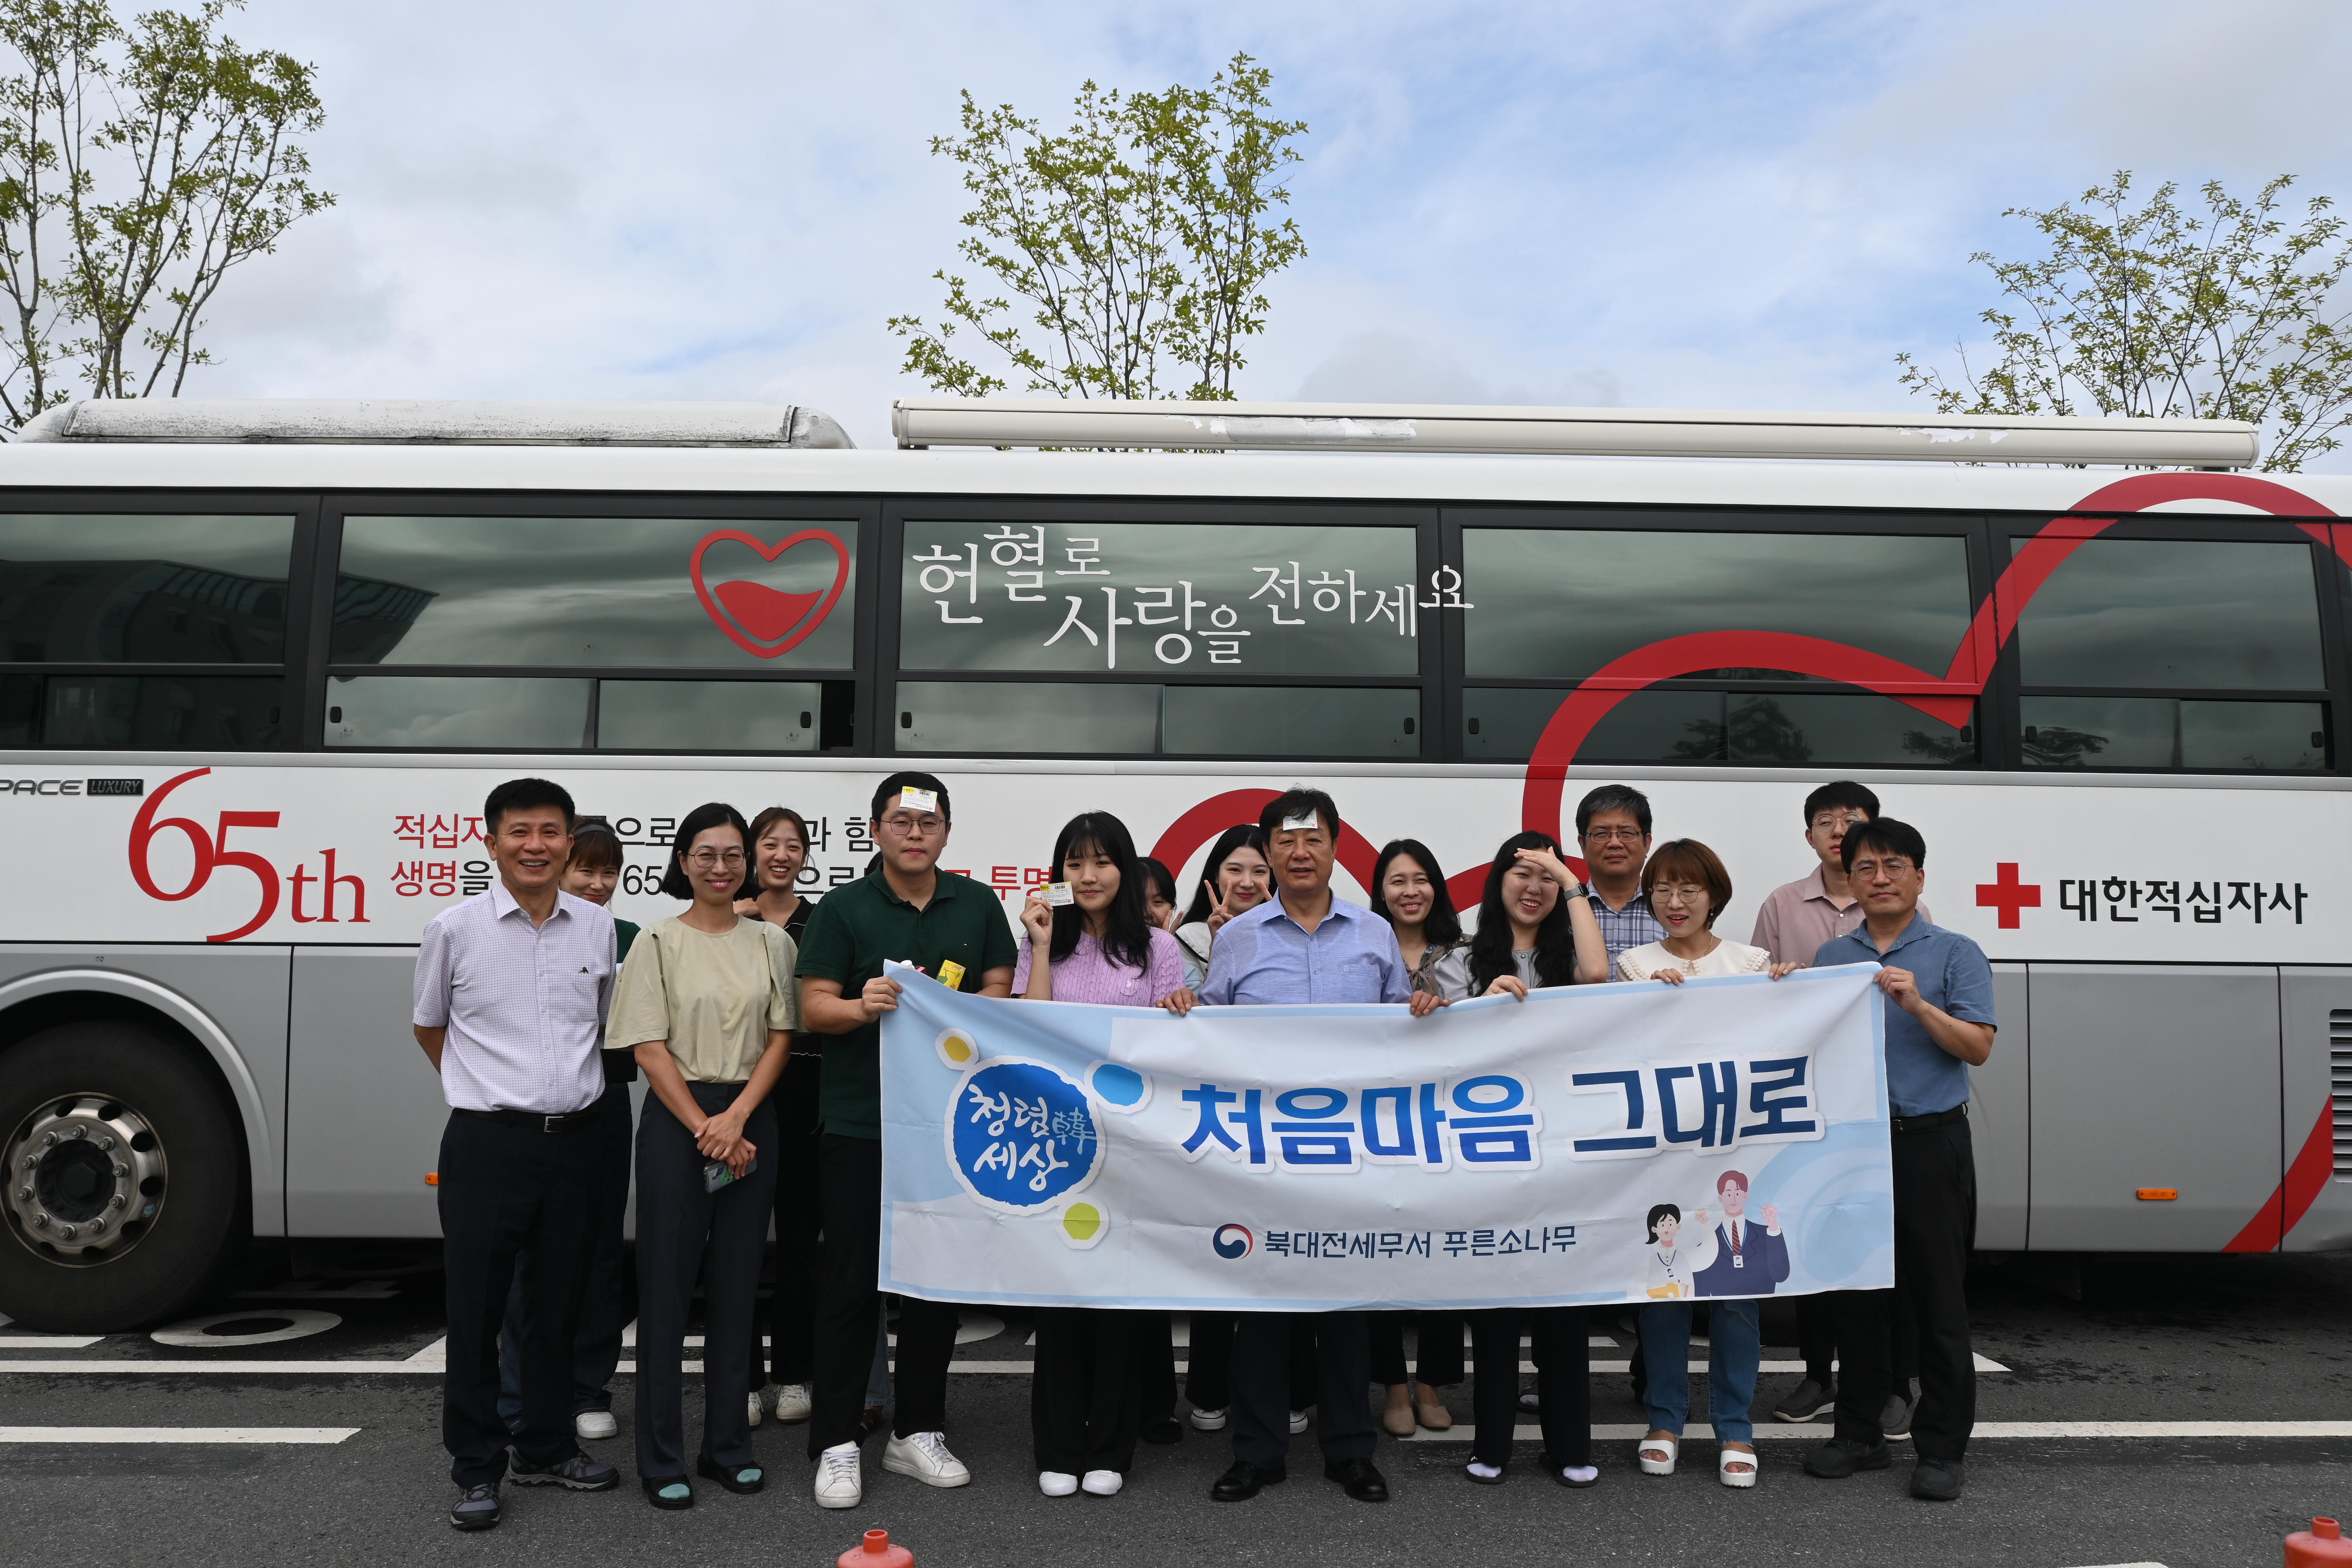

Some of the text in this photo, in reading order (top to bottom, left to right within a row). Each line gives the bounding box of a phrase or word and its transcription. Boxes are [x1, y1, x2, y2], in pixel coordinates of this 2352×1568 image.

[912, 525, 1474, 670] 헌혈로 사랑을 전하세요
[90, 781, 140, 793] LUXURY
[128, 767, 370, 942] 65th
[390, 860, 493, 896] 생명을
[2060, 876, 2308, 924] 대한적십자사
[1181, 1055, 1816, 1165] 처음마음 그대로
[974, 1139, 1069, 1191] 세상
[1265, 1226, 1576, 1259] 북대전세무서 푸른소나무
